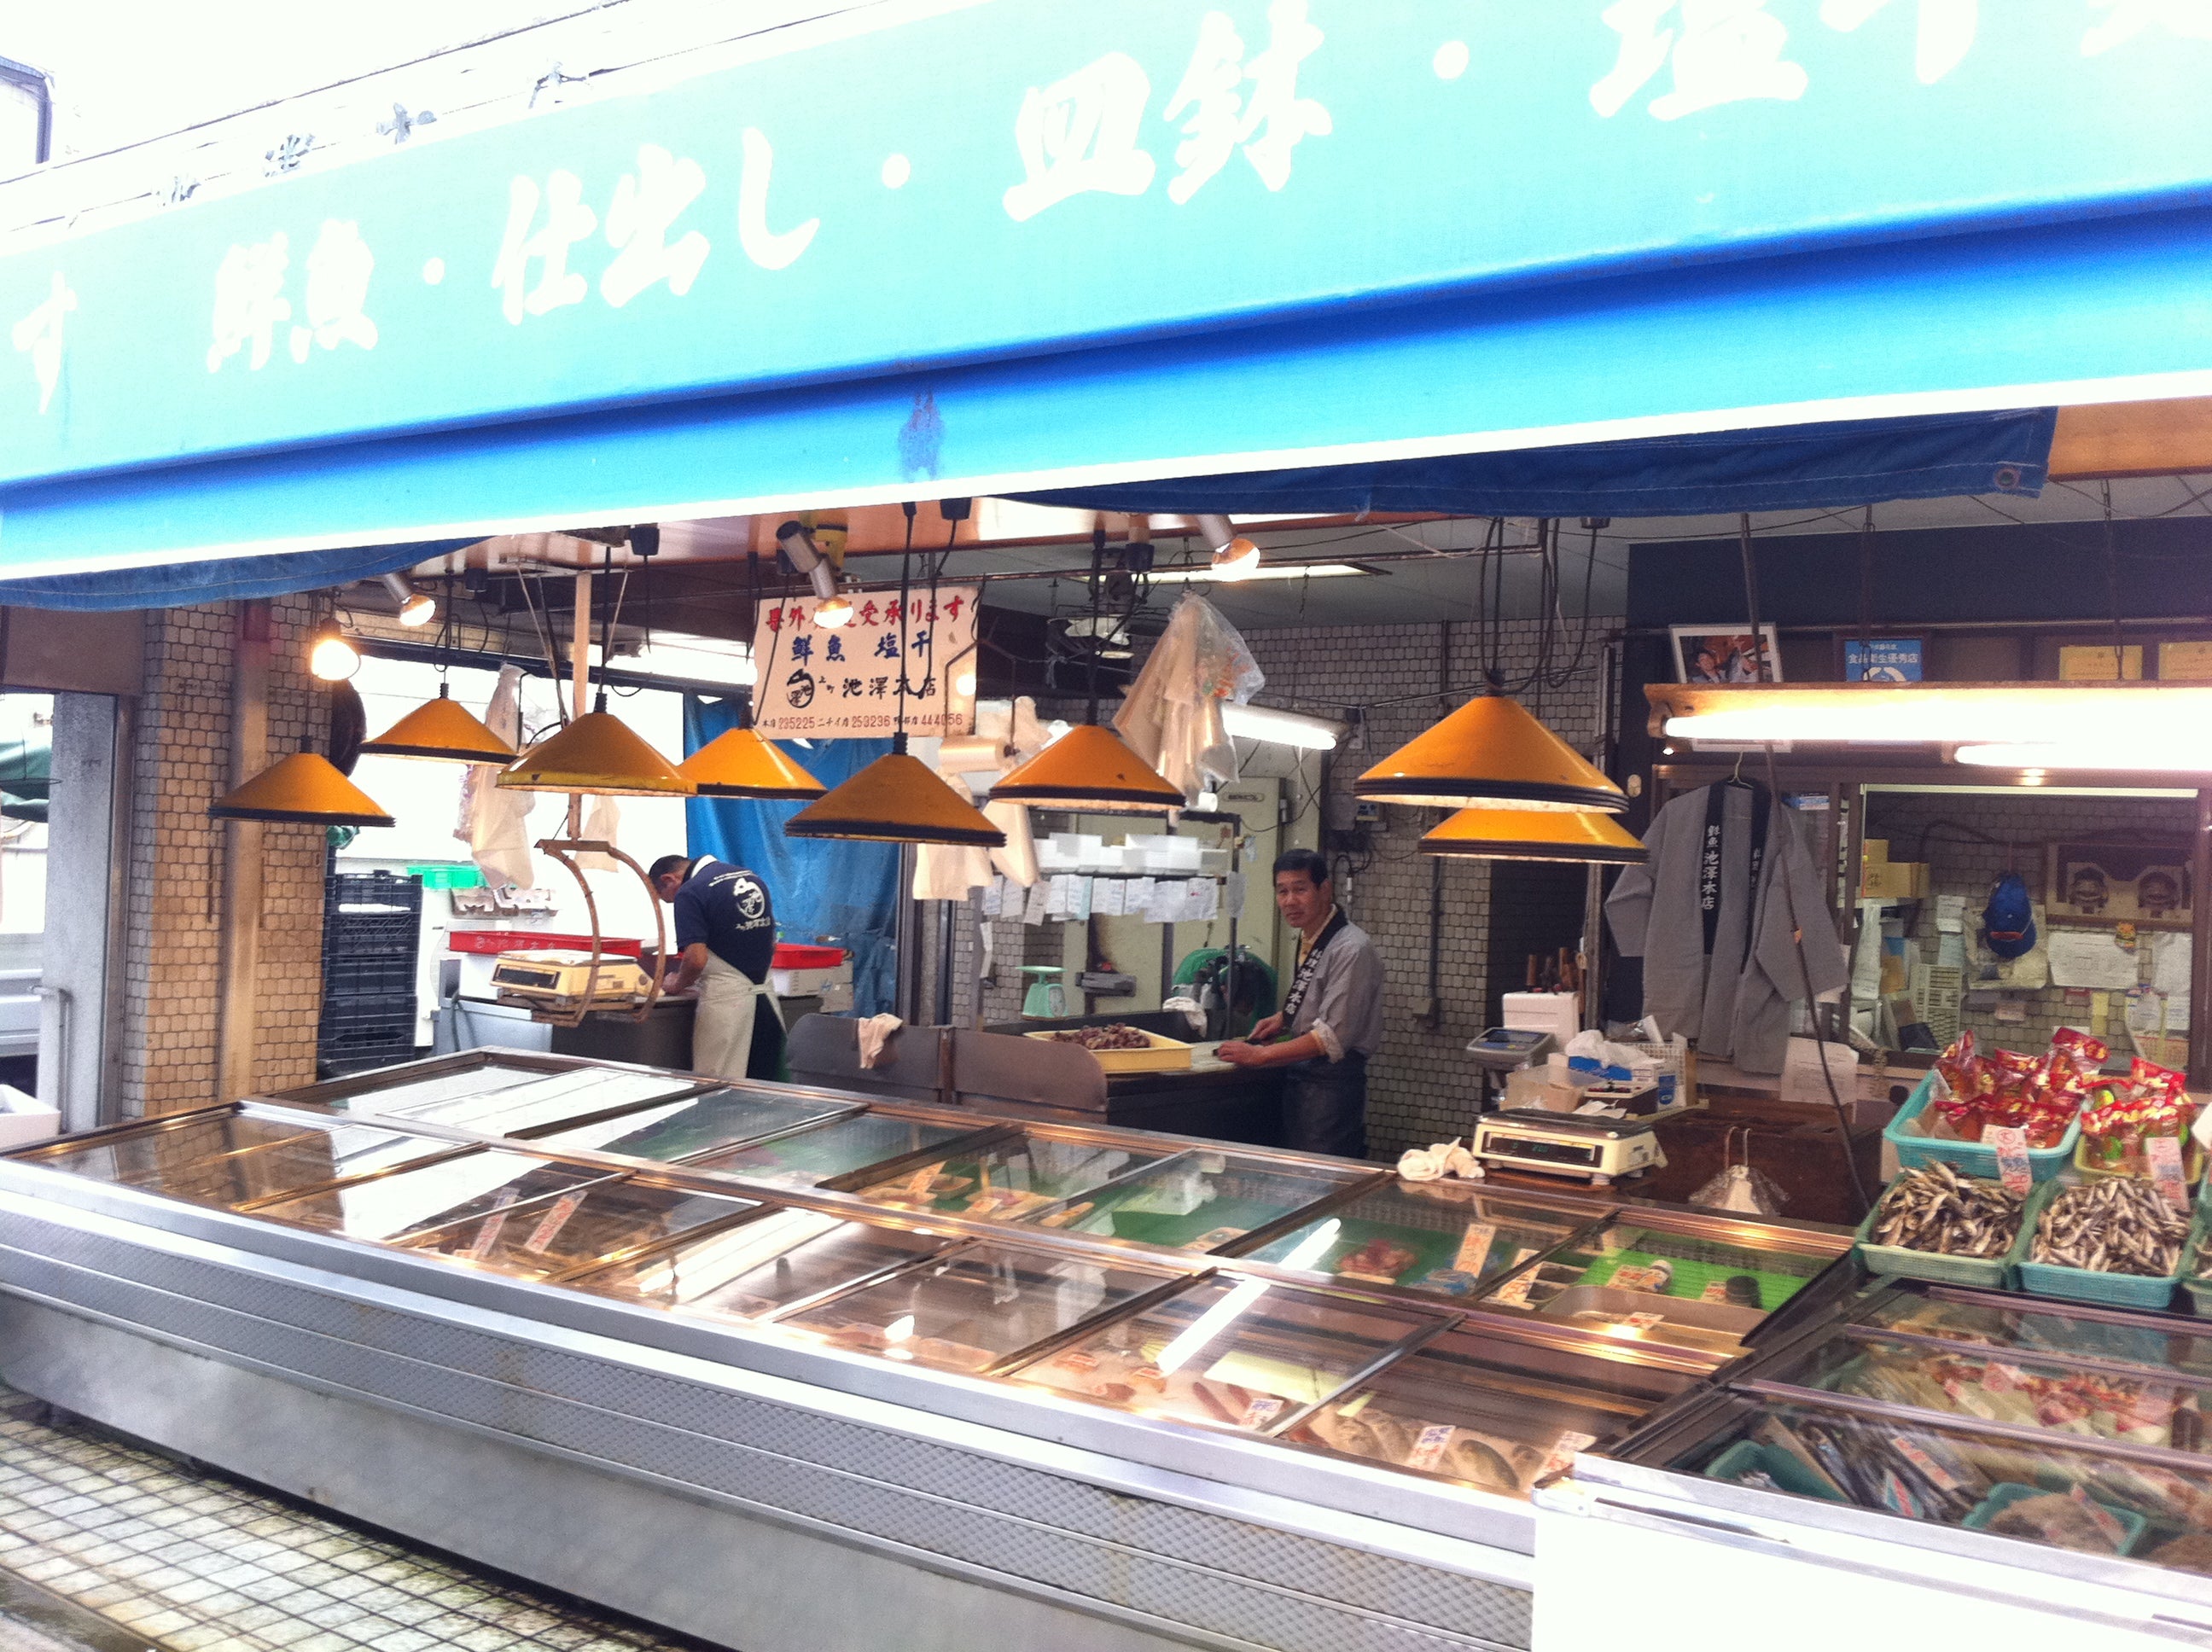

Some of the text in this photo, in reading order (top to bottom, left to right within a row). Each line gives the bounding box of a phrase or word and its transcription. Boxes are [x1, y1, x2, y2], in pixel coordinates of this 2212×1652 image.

[207, 218, 378, 373] 鮮魚
[492, 126, 820, 325] 仕出し
[1003, 0, 1333, 222] 皿鉢
[791, 634, 846, 666] 鮮魚
[778, 716, 815, 730] 235225
[851, 715, 891, 729] 253236
